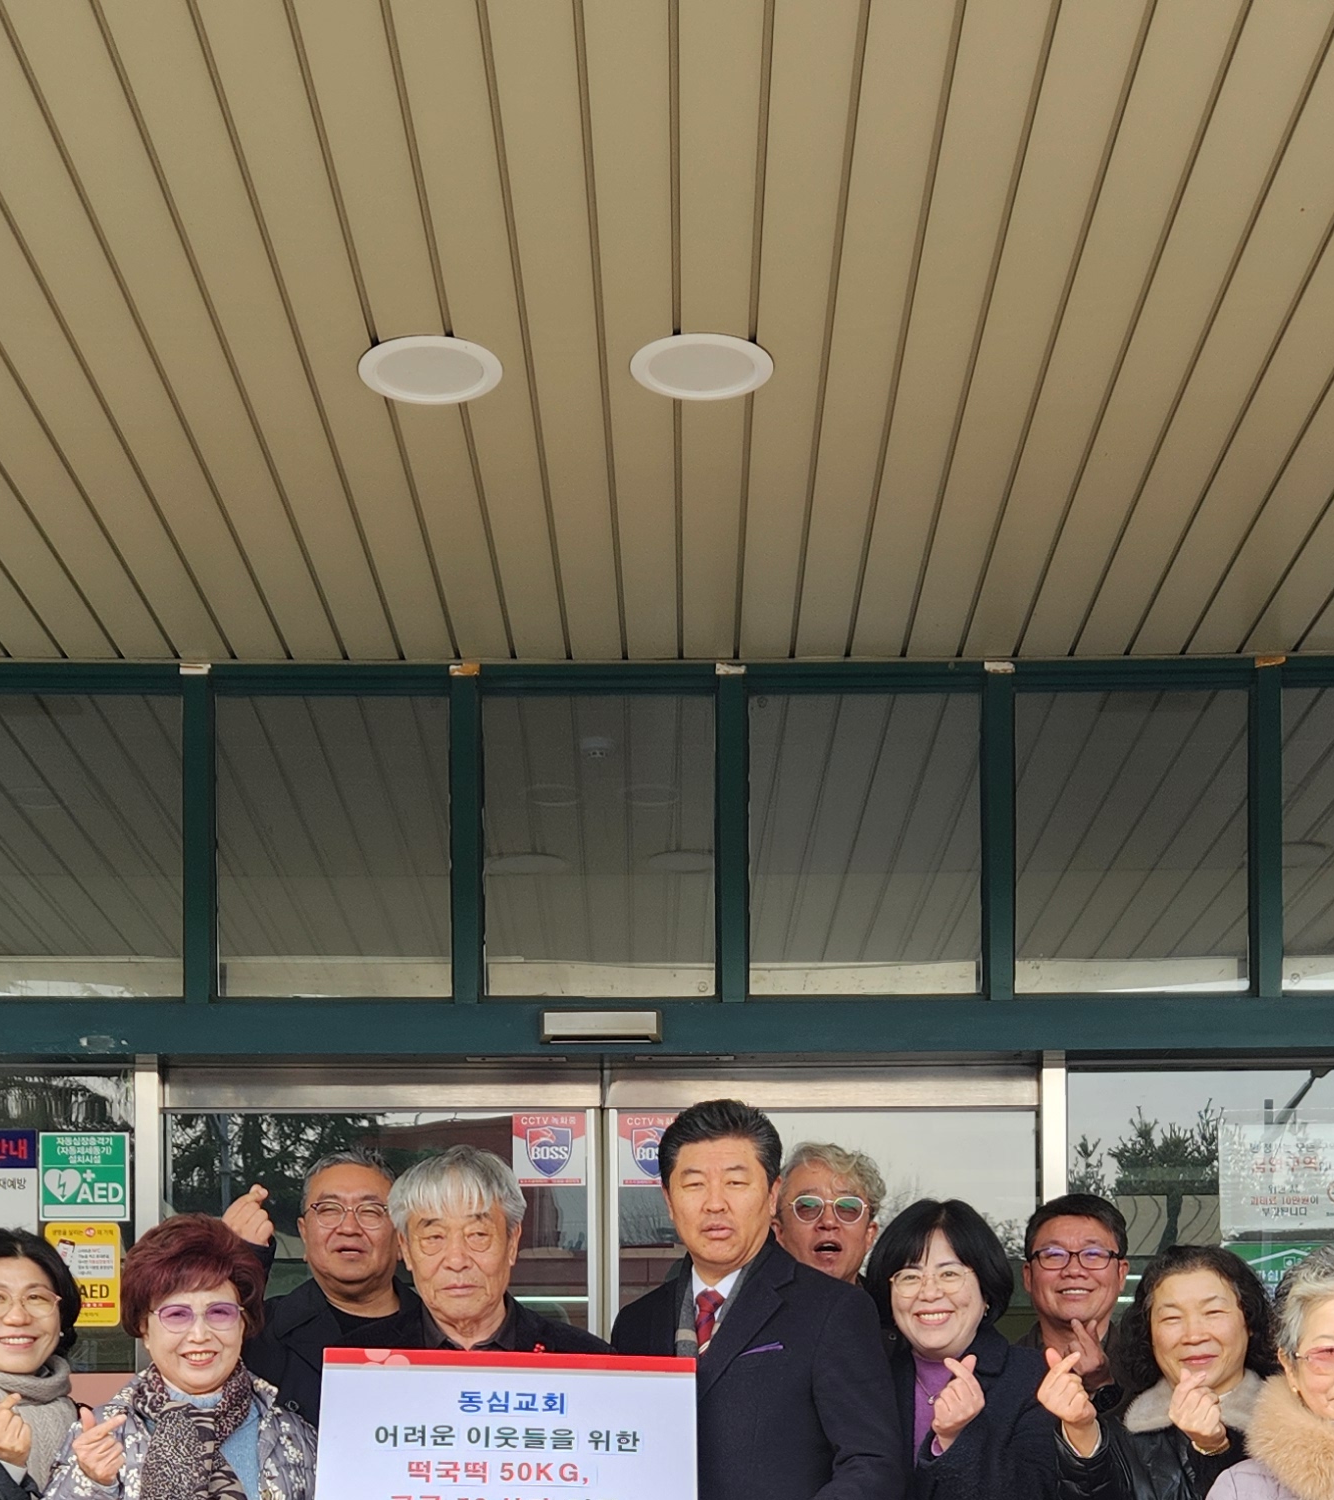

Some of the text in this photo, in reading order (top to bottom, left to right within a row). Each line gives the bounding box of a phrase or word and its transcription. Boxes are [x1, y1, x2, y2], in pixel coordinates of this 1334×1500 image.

[521, 1117, 549, 1125] CCTV
[627, 1117, 654, 1125] CCTV
[56, 1137, 113, 1146] 자동심장충격기
[56, 1146, 112, 1155] (자동제세동기)
[531, 1147, 568, 1159] BOSS
[68, 1155, 101, 1164] 설치시설
[77, 1182, 123, 1203] AED
[1250, 1196, 1277, 1206] 과태료
[80, 1284, 109, 1298] AED
[457, 1390, 566, 1414] 동심교회
[374, 1424, 640, 1454] 어려운 이웃들을 위한
[407, 1460, 590, 1486] 떡국떡 50KG,
